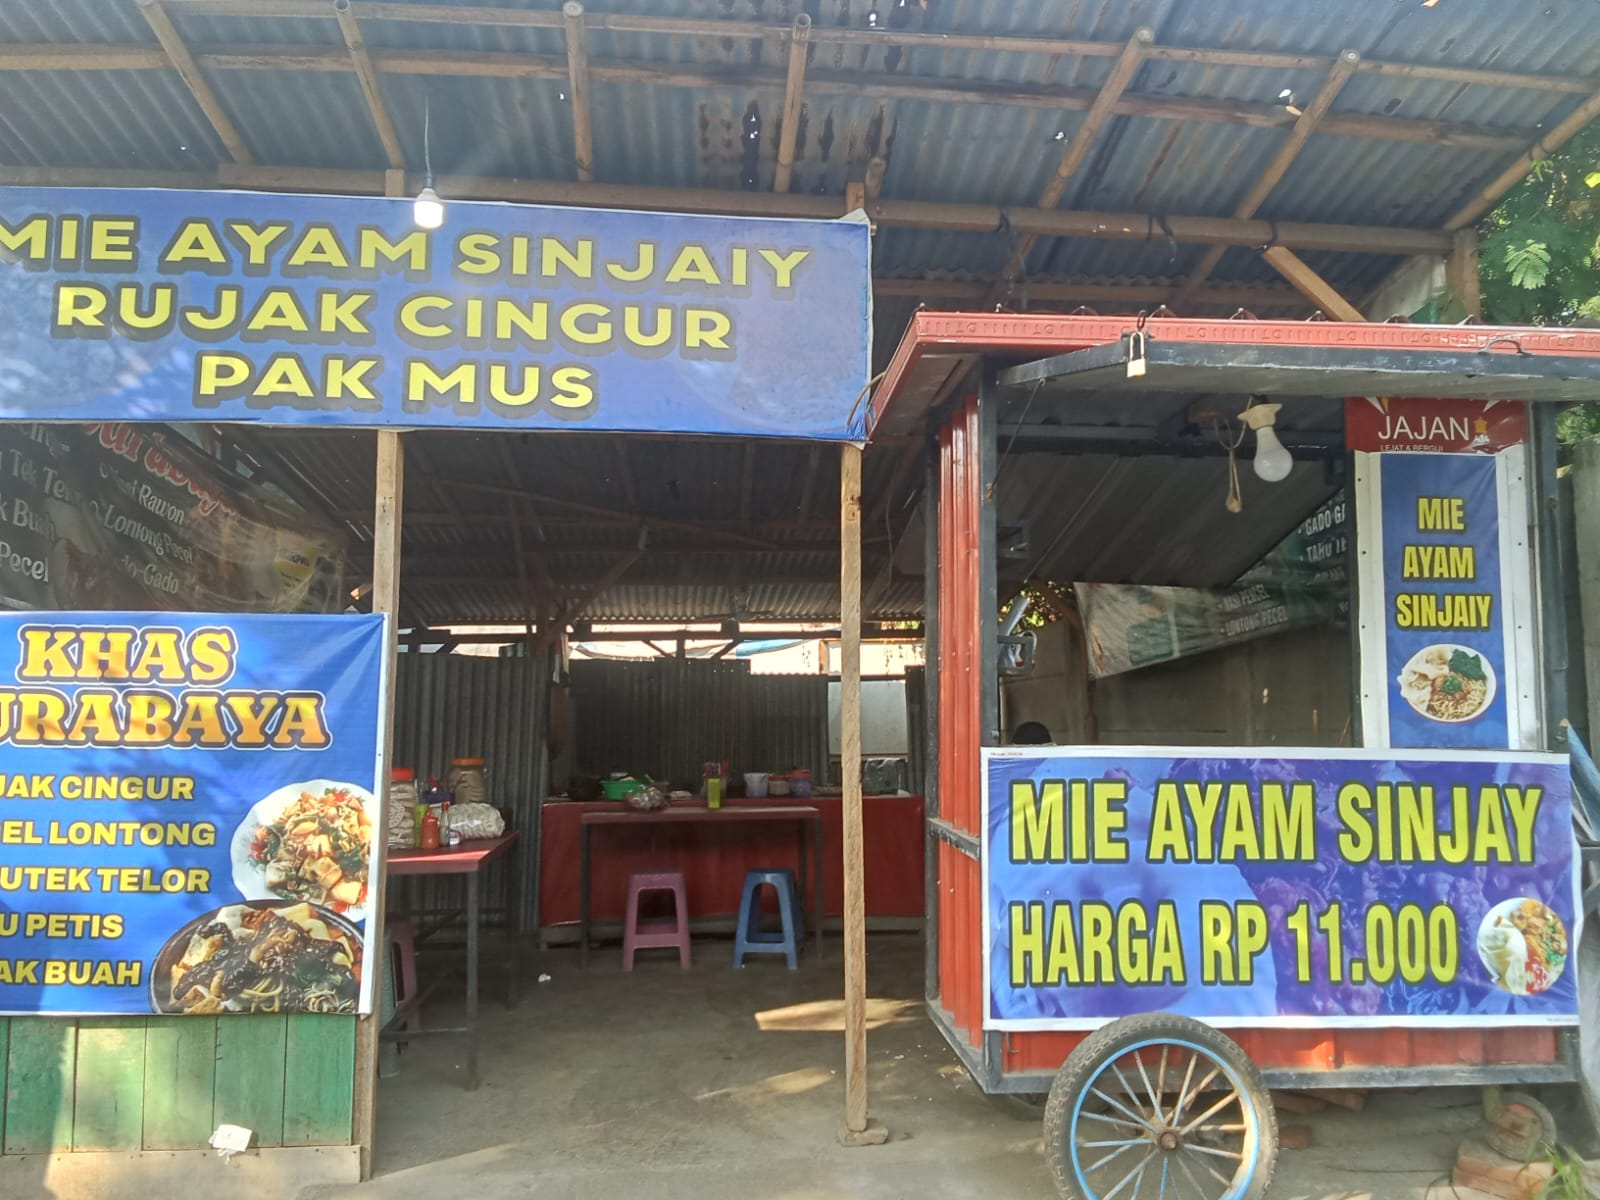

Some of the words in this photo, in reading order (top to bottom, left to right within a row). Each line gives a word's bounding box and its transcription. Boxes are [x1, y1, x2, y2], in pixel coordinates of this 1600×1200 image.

[0, 218, 136, 262] MIE
[164, 222, 428, 273] AYAM
[457, 233, 810, 289] SINJAIY
[56, 285, 371, 335] RUJAK
[399, 295, 732, 350] CINGUR
[198, 354, 378, 401] PAK
[407, 361, 594, 409] MUS
[1377, 415, 1470, 441] JAJAN
[138, 483, 185, 525] Rawon
[1417, 497, 1466, 531] MIE
[0, 540, 49, 583] Pecel
[1402, 545, 1475, 579] AYAM
[1395, 594, 1492, 628] SINJAIY
[20, 627, 235, 684] KHAS
[0, 774, 56, 799] AK
[59, 775, 194, 800] CINGUR
[49, 820, 217, 847] LONTONG
[1009, 781, 1129, 863] MIE
[1146, 781, 1317, 863] AYAM
[1337, 782, 1543, 865] SINJAY
[0, 866, 92, 892] UTEK
[96, 867, 210, 893] TELOR
[25, 913, 125, 939] PETIS
[1010, 902, 1187, 986] HARGA
[1200, 902, 1269, 984] RP
[1286, 902, 1460, 986] 11.000
[44, 960, 141, 986] BUAH
